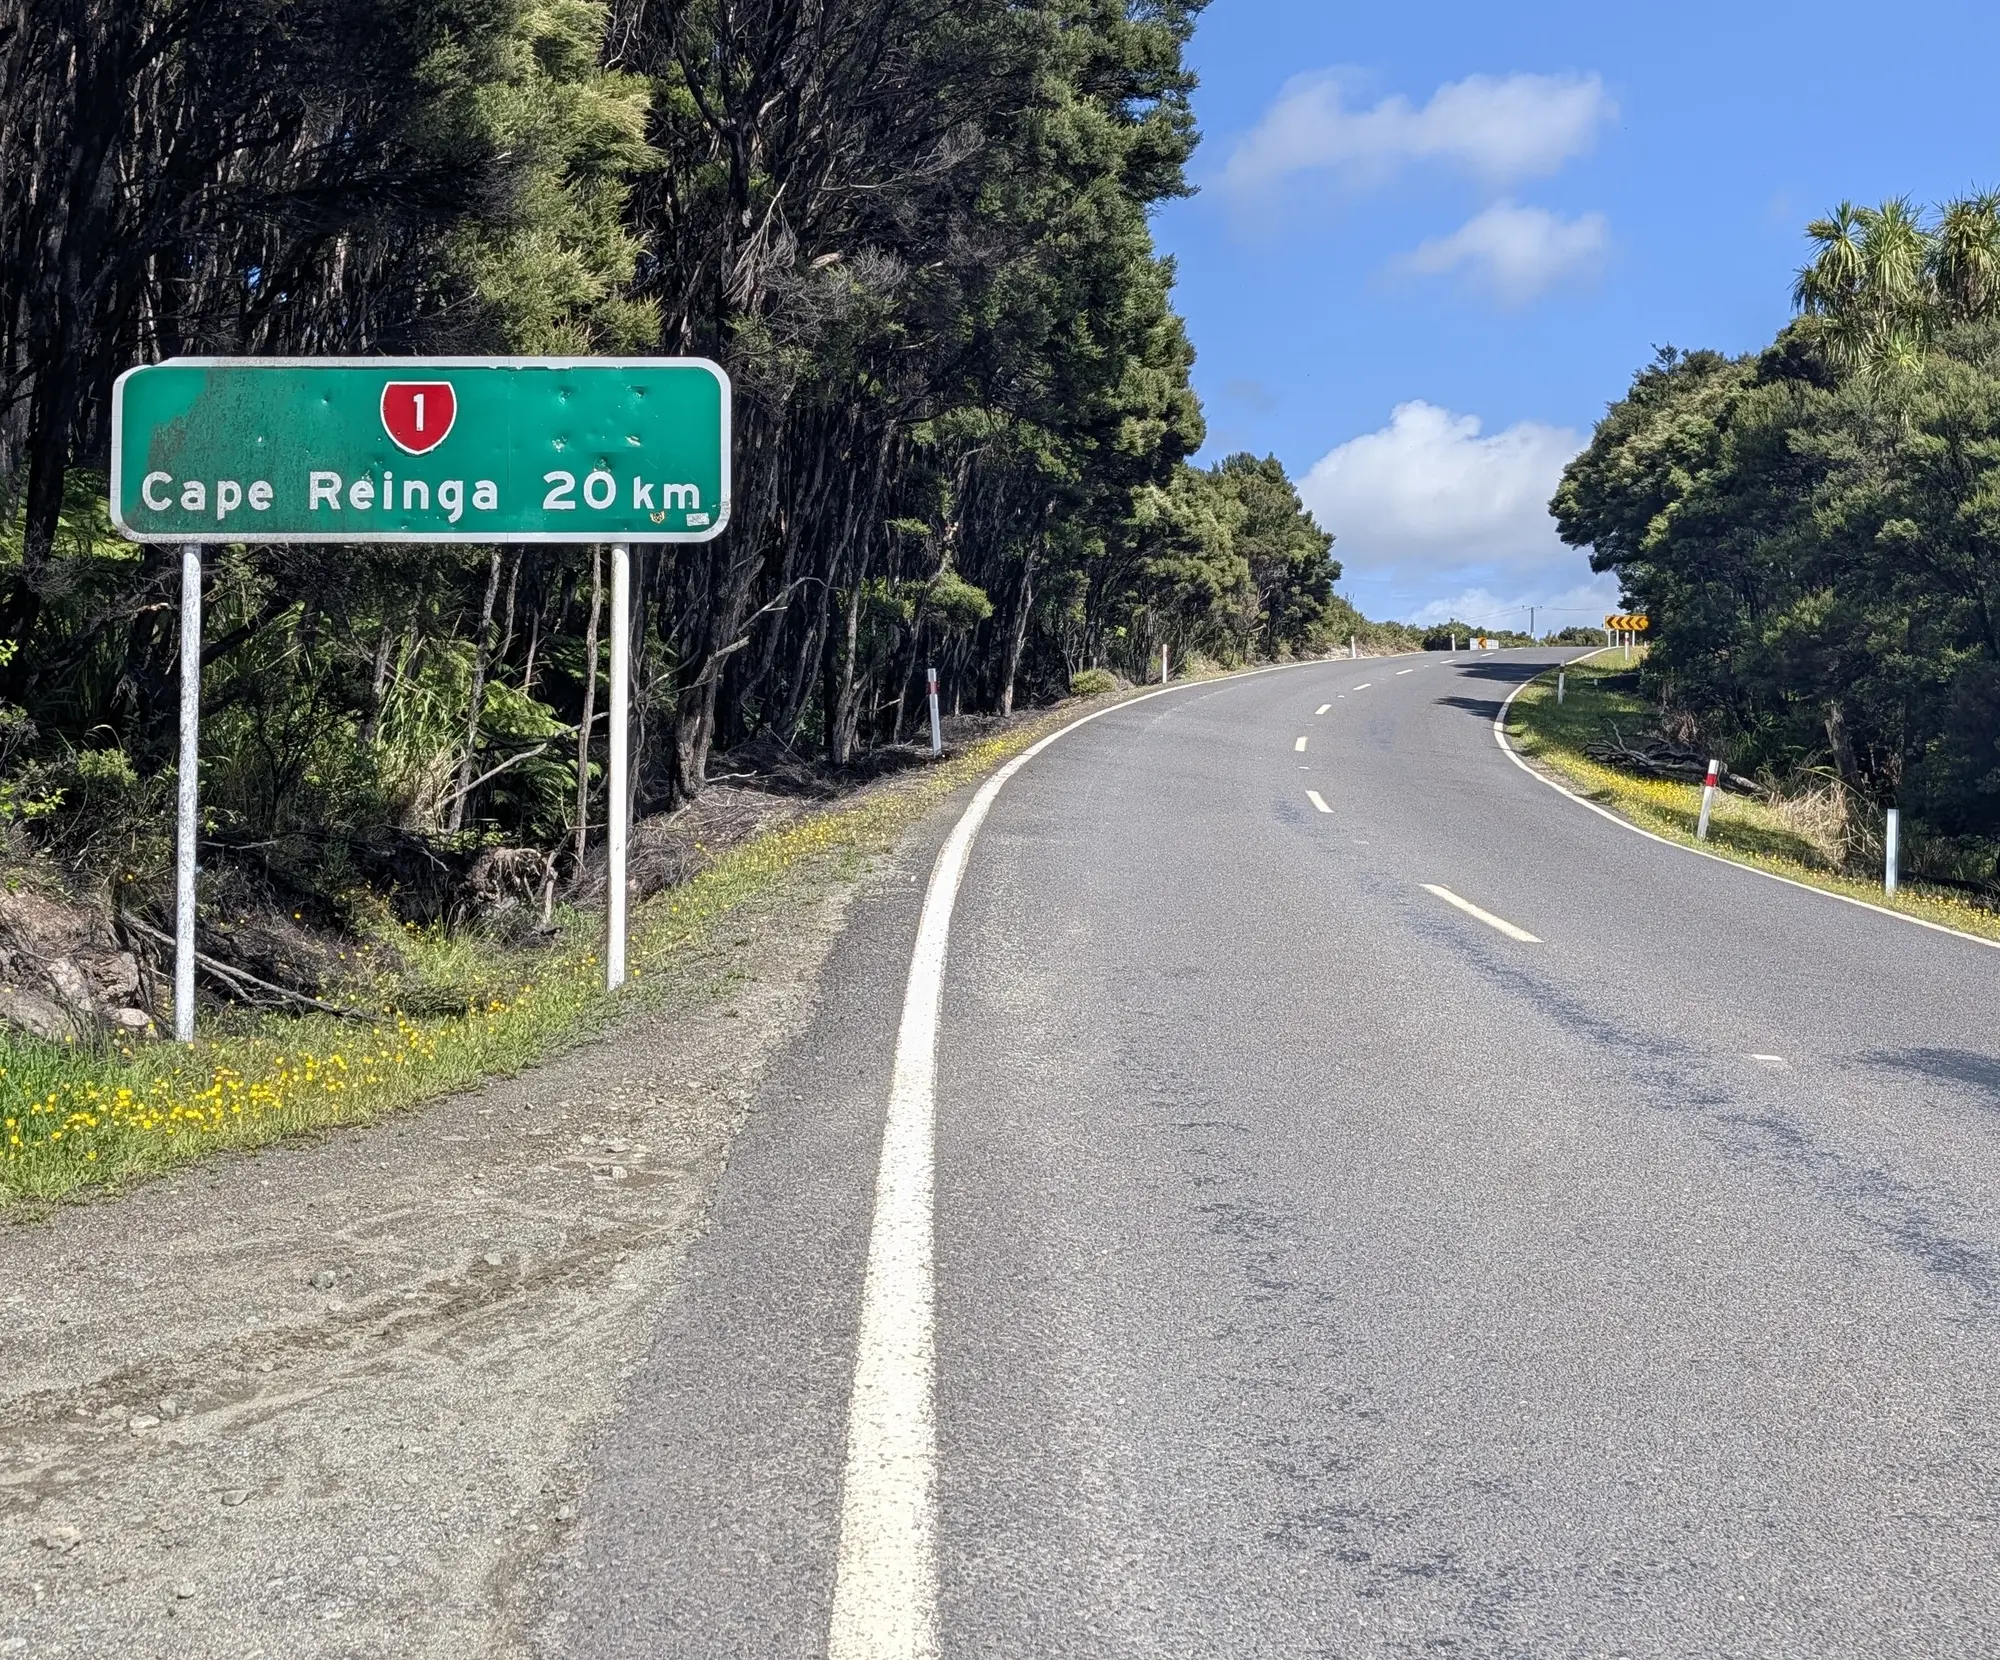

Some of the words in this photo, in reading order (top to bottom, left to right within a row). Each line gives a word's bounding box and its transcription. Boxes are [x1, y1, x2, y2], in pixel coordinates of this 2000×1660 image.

[412, 394, 425, 432] 1
[141, 471, 274, 520] Cape
[309, 471, 498, 522] Reinga
[543, 471, 617, 510] 20
[633, 475, 700, 510] km
